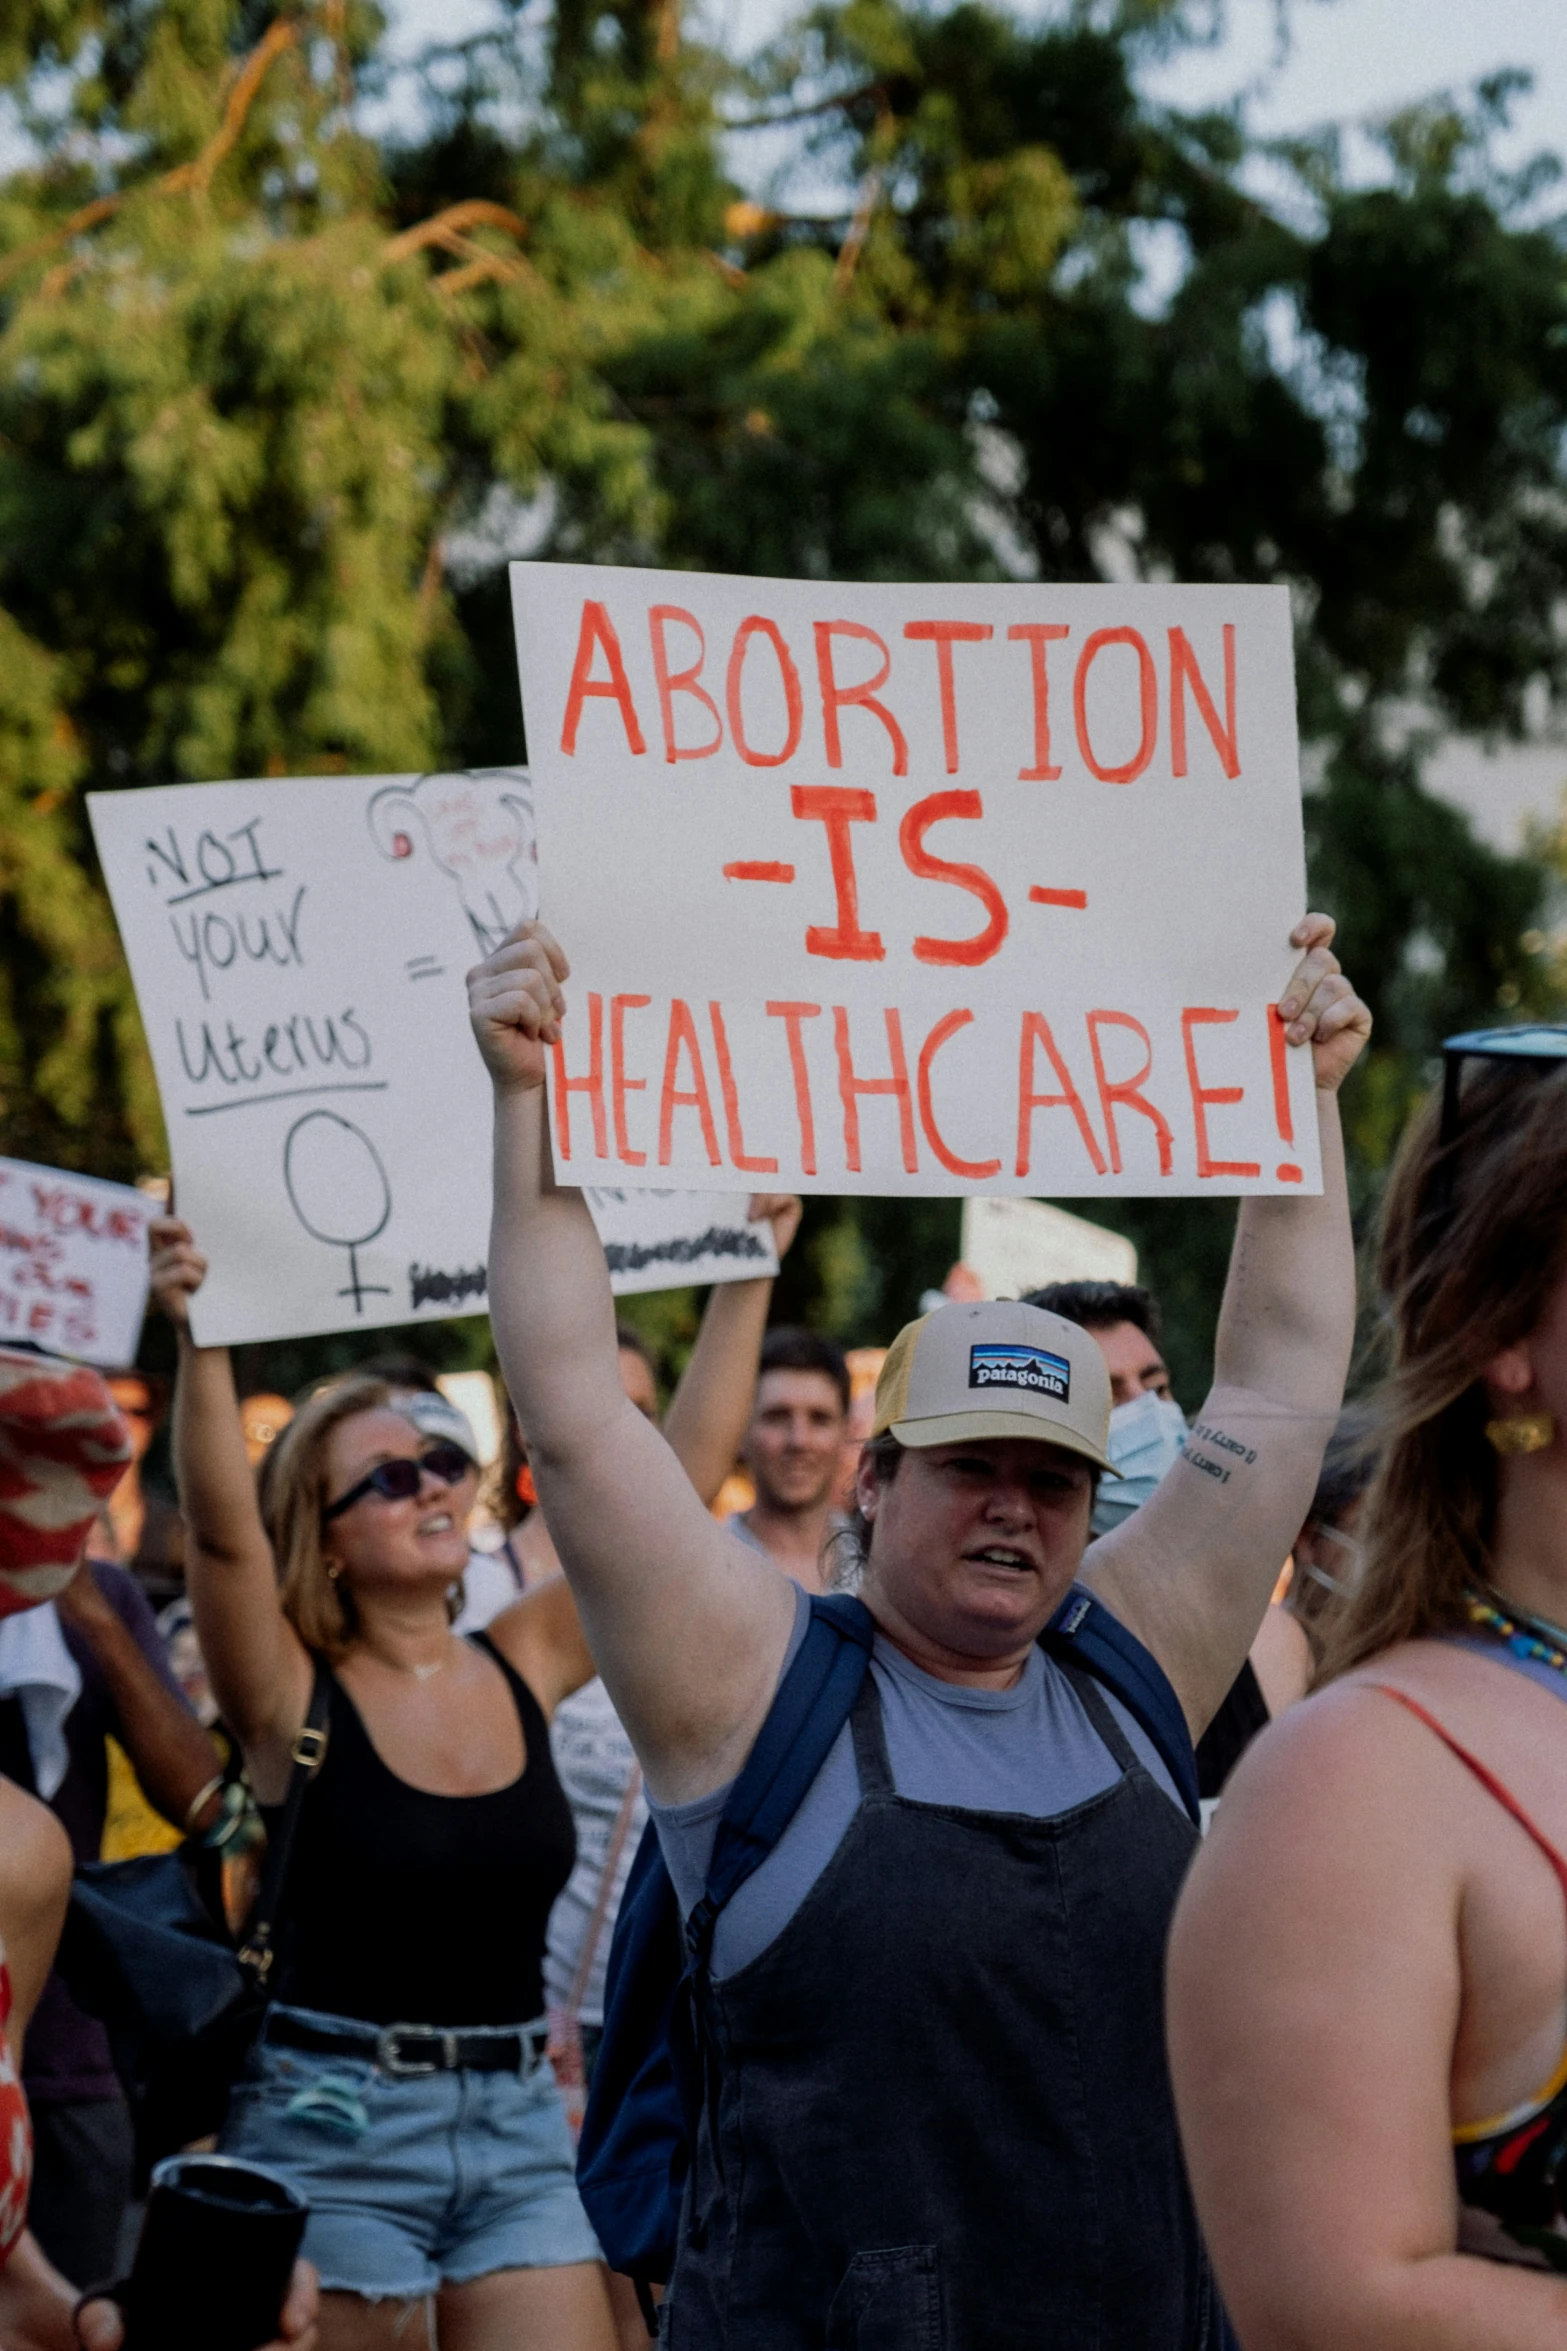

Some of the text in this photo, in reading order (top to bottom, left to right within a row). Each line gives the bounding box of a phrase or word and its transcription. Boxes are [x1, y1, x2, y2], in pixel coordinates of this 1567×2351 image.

[561, 600, 1241, 783] ABORTION
[146, 817, 266, 886] NOT
[553, 993, 1302, 1183] HEALTHCARE!
[976, 1368, 1064, 1394] patagonia
